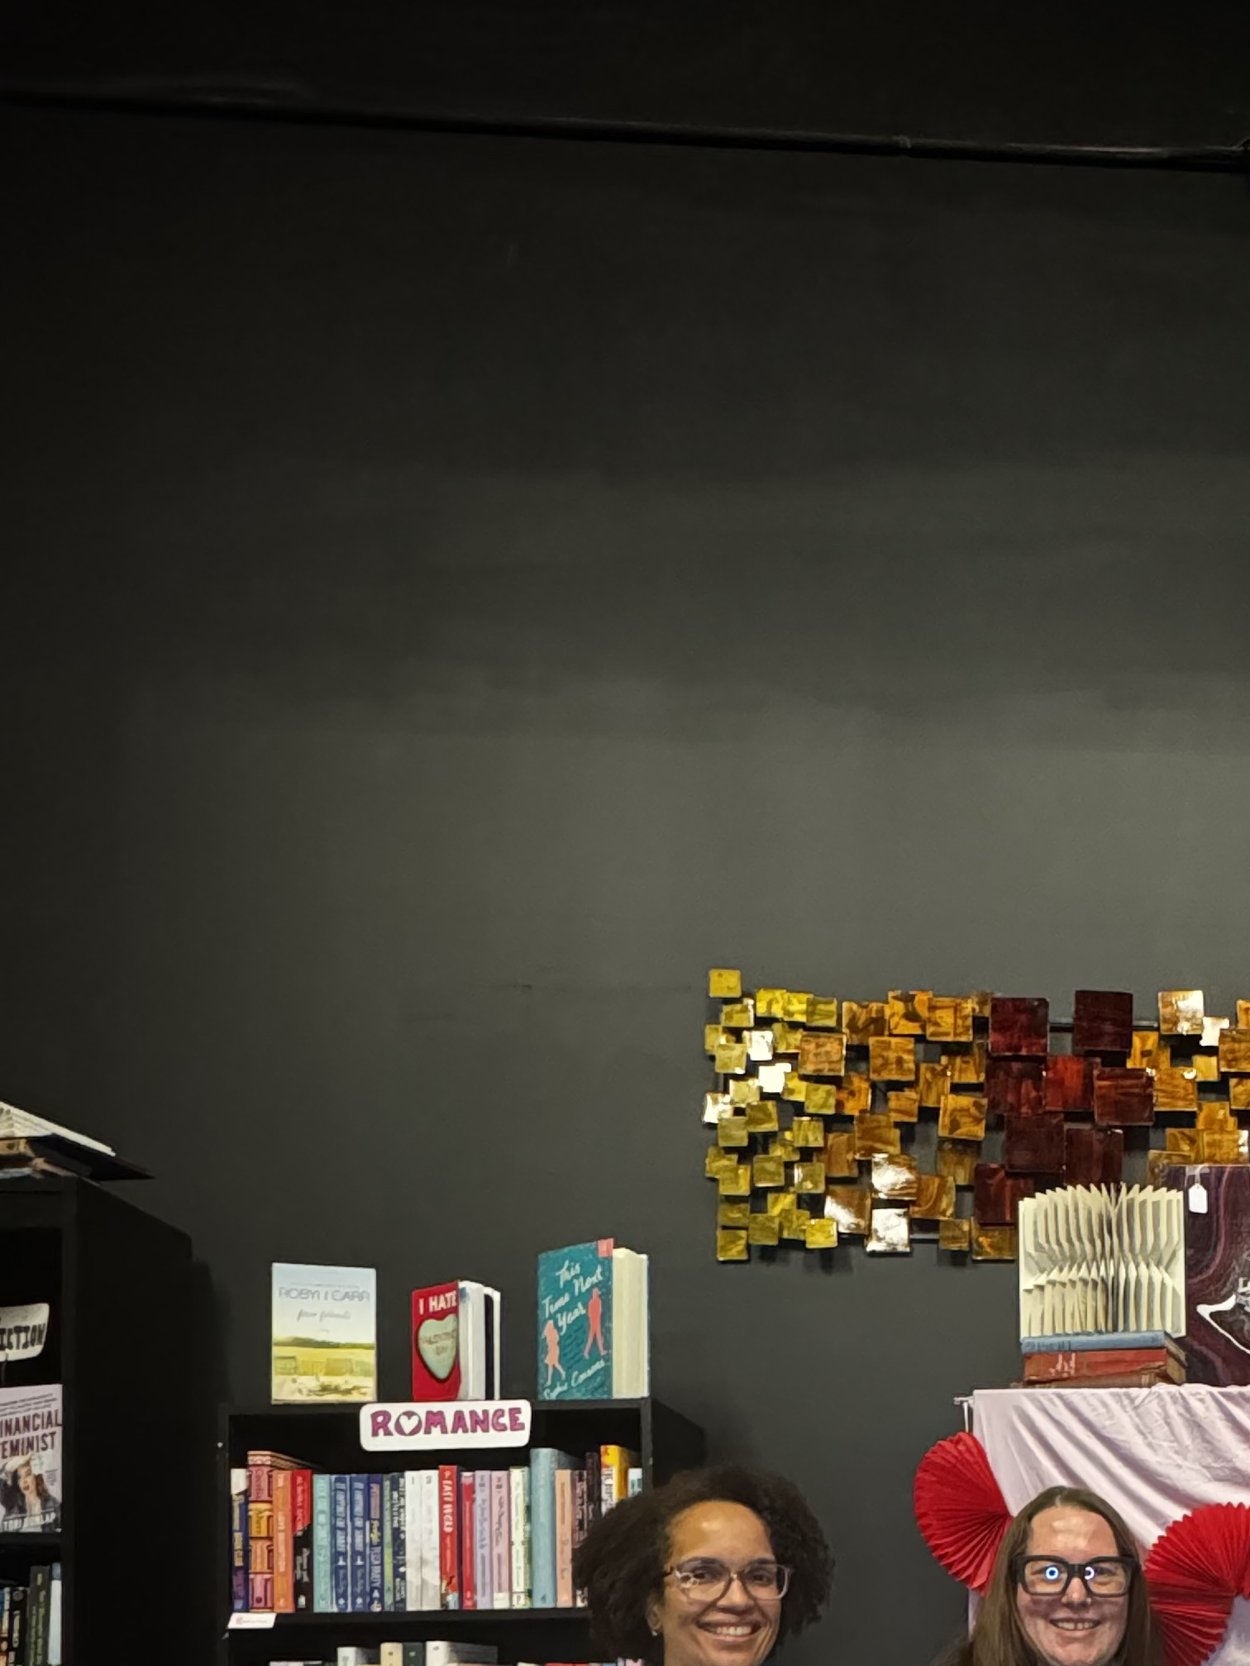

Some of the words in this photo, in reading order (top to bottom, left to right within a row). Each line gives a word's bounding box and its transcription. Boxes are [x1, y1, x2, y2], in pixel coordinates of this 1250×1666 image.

[428, 1290, 457, 1313] HATE
[0, 1323, 46, 1350] ICTION
[0, 1409, 62, 1438] INANCIAL
[371, 1407, 525, 1437] ROMANCE
[0, 1431, 56, 1459] EMINIST
